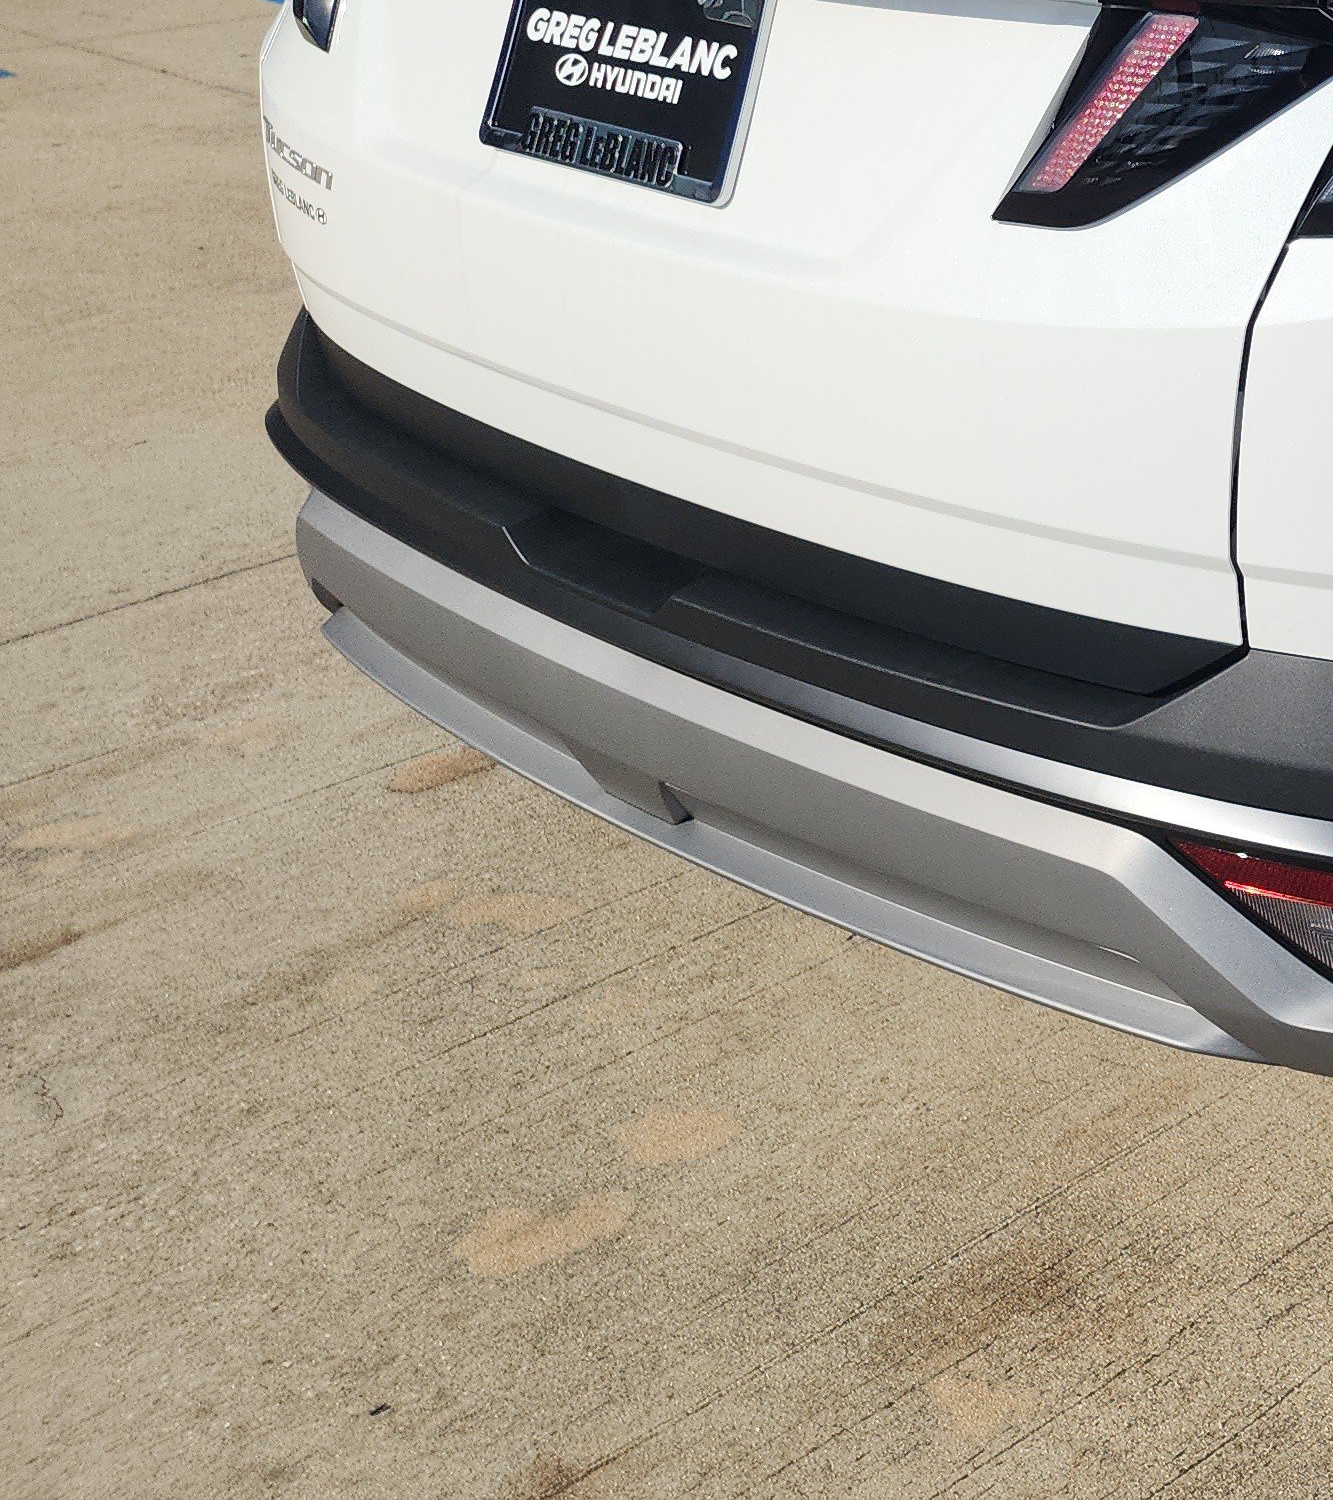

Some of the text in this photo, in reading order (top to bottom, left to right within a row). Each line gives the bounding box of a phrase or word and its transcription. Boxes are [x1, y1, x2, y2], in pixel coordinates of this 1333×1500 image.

[526, 7, 738, 80] GREG LEBLANC
[588, 62, 683, 105] HYUNDAI
[520, 112, 584, 163] GREG
